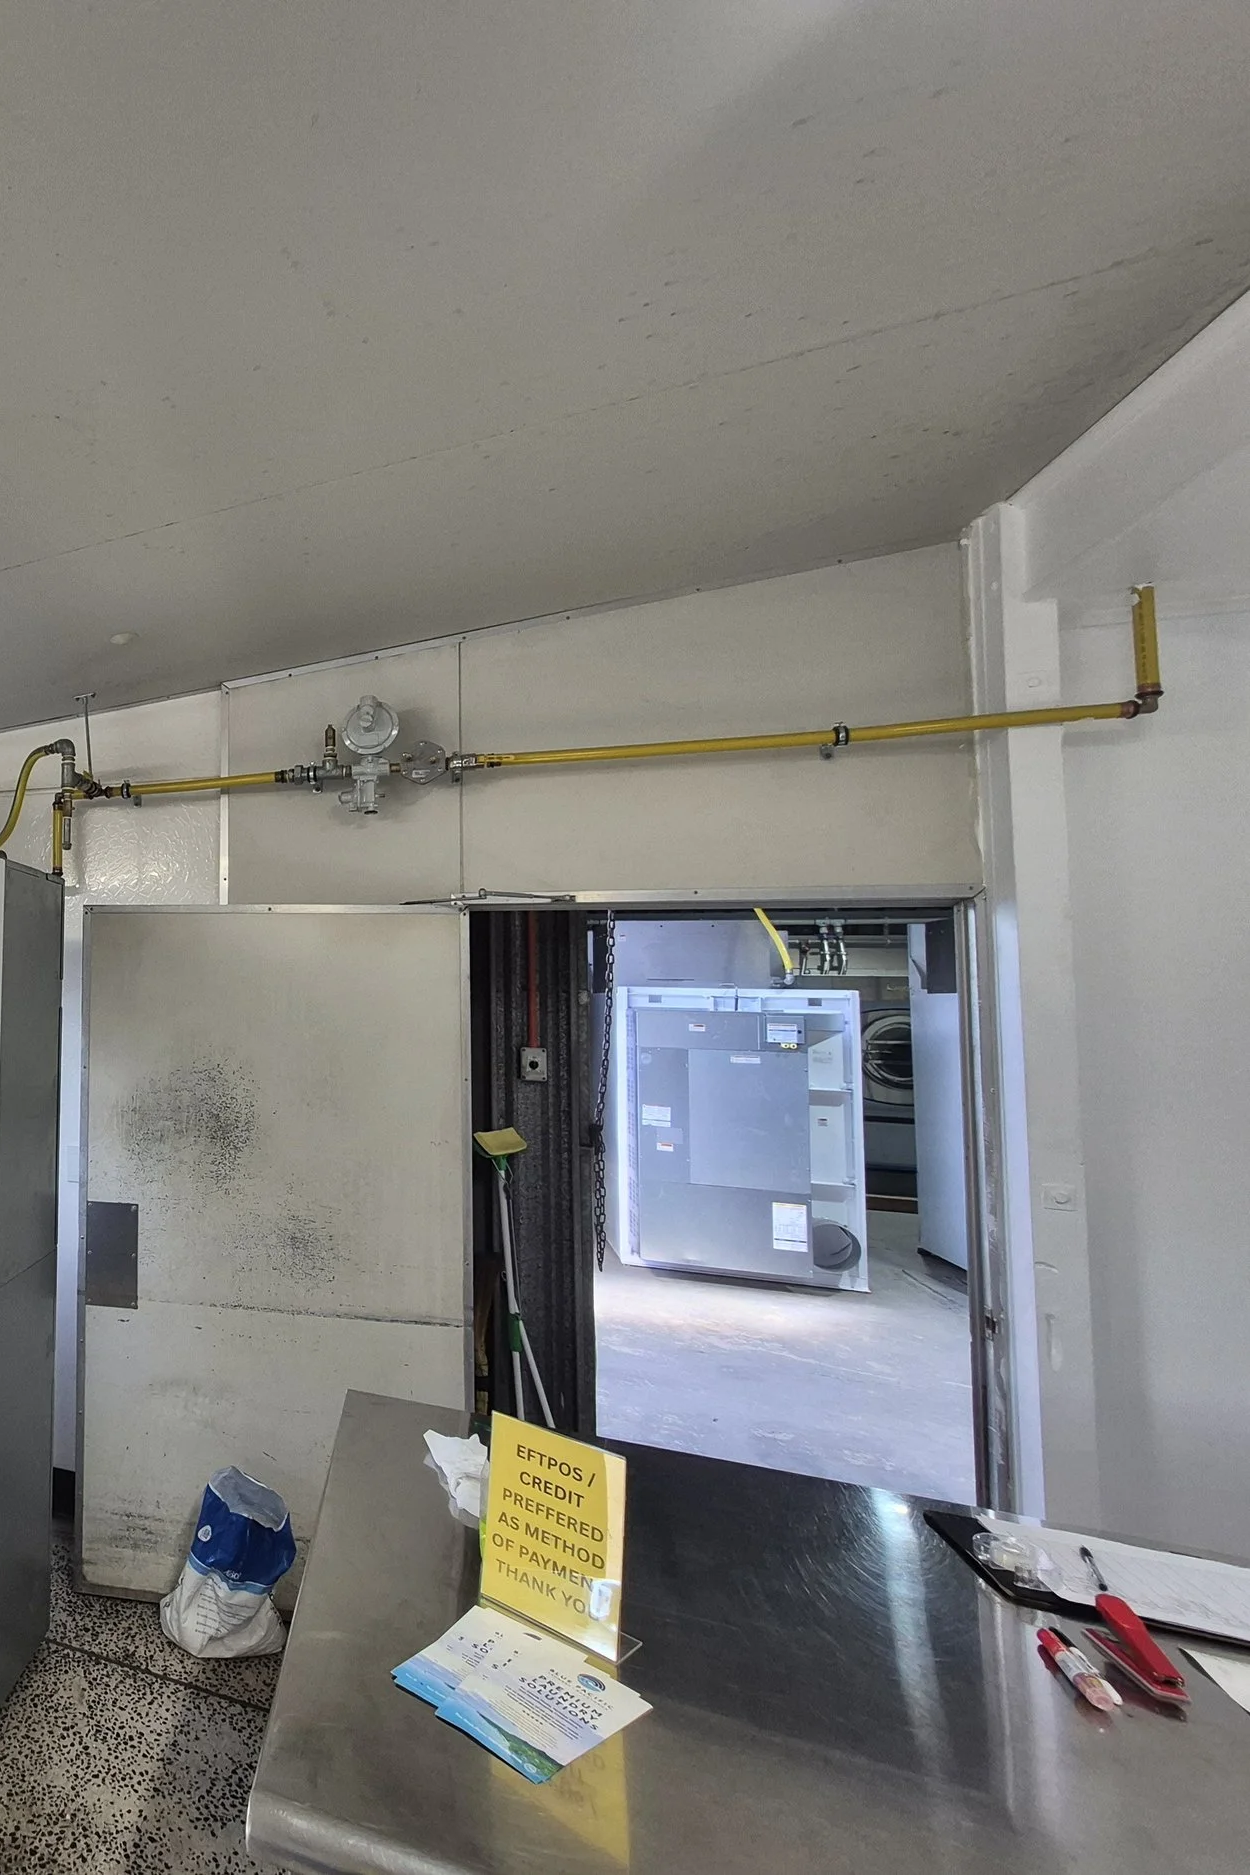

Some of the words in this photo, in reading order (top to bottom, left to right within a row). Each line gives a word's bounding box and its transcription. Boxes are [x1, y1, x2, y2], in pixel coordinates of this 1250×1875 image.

[516, 1444, 583, 1482] EFTPOS
[587, 1473, 596, 1487] /
[519, 1471, 585, 1508] CREDIT
[502, 1487, 604, 1543] PREFFERED
[498, 1511, 520, 1531] AS
[525, 1522, 605, 1570] METHOD
[492, 1533, 515, 1551] OF
[519, 1545, 595, 1593] PAYMEN
[495, 1558, 556, 1601] THANK
[518, 1676, 599, 1731] SOLUTIONS
[531, 1678, 598, 1721] LAUNDRY
[538, 1675, 603, 1718] PREMIUM
